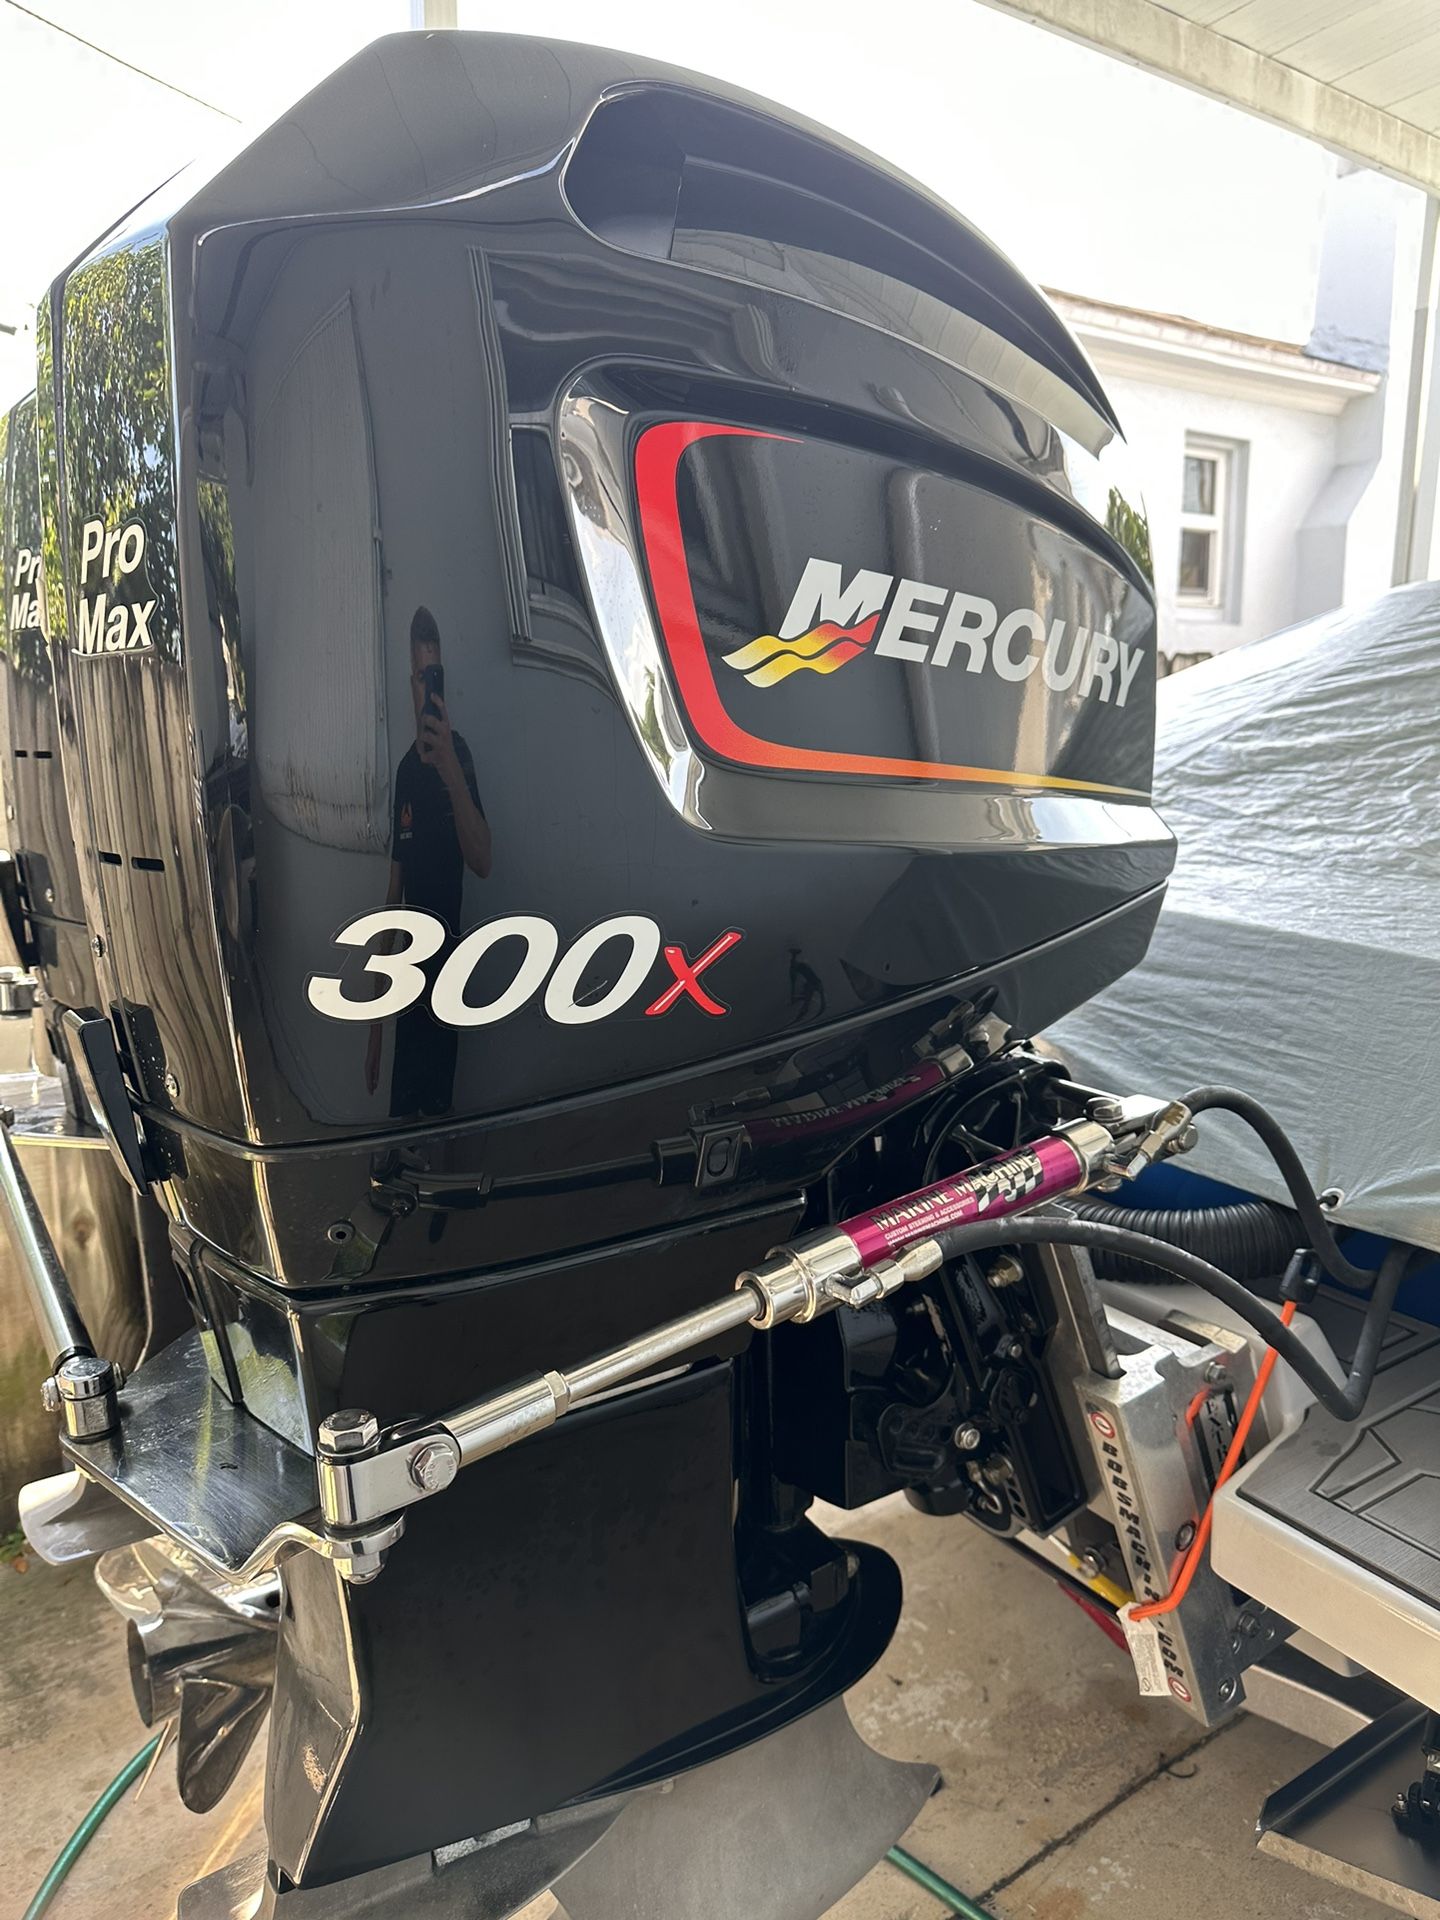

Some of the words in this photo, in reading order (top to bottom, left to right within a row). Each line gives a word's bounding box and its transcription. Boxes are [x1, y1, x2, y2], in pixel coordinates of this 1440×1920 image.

[14, 548, 41, 587] Pr
[81, 519, 145, 584] Pro
[10, 592, 41, 631] Ma
[79, 593, 156, 654] Max
[778, 557, 1145, 708] MERCURY
[870, 1188, 954, 1231] MARINE
[948, 1147, 1040, 1197] MACHINE
[1102, 1441, 1184, 1678] BOBSMACHIN.COM
